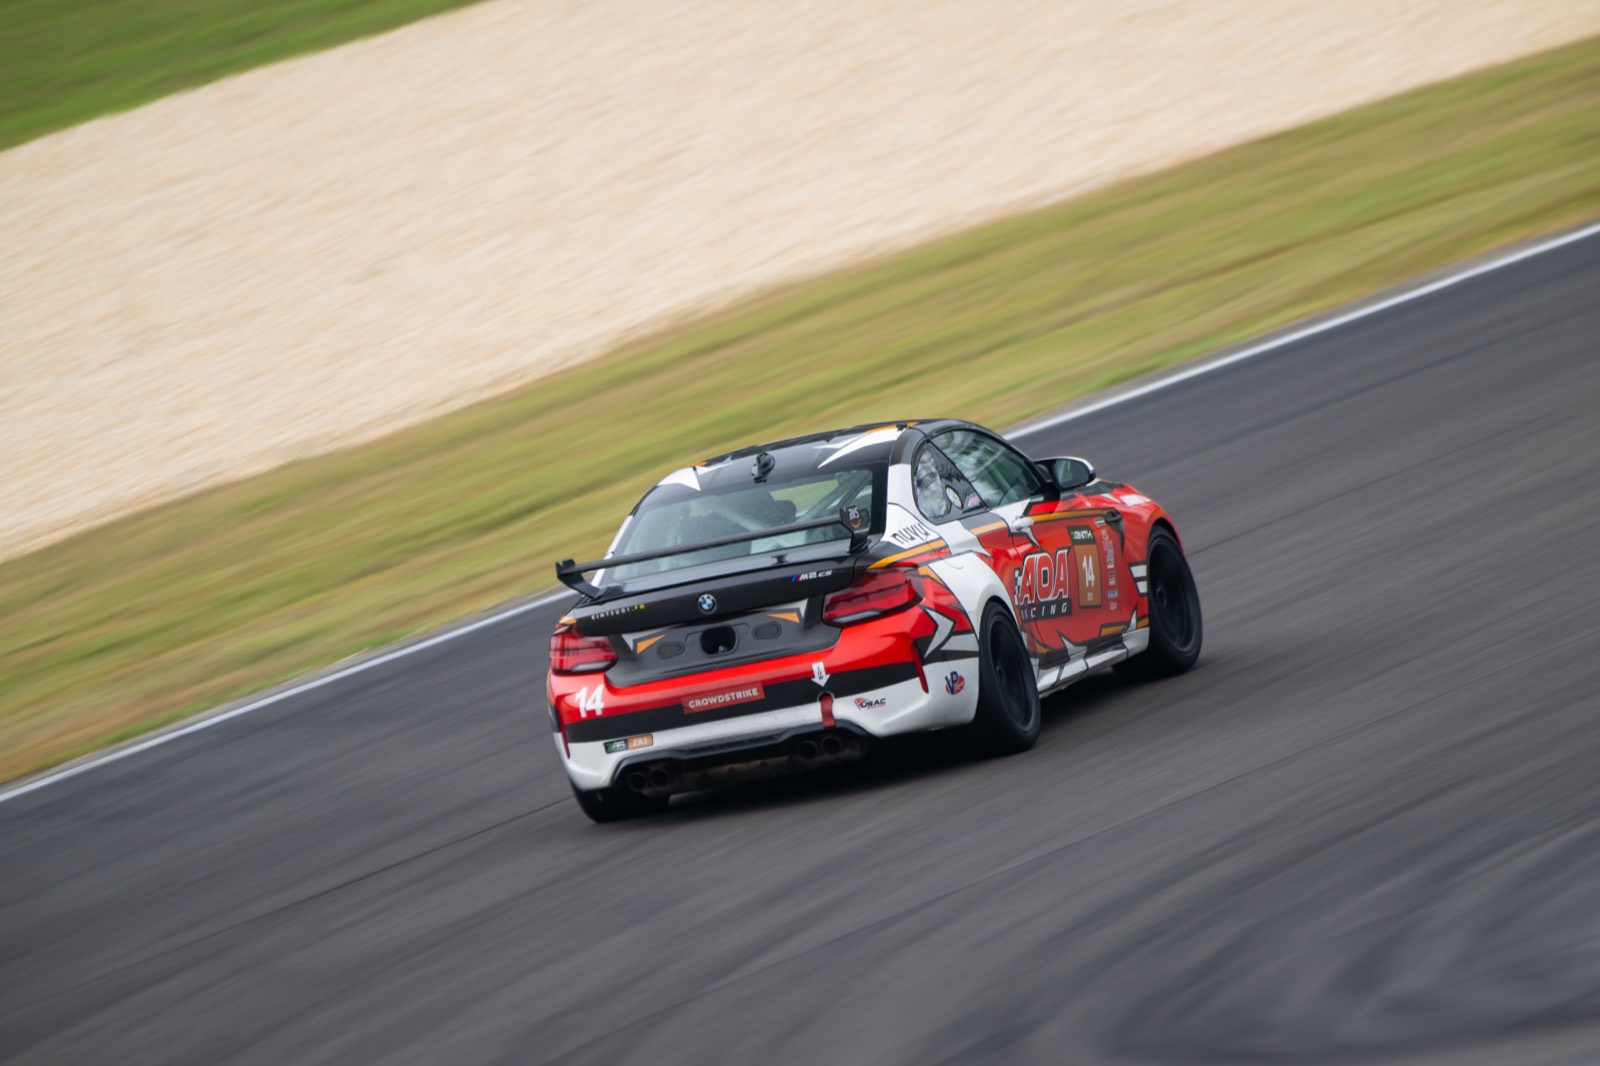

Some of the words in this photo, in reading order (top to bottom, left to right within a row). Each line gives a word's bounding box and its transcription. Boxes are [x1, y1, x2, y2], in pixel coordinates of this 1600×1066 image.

[1019, 549, 1070, 605] AOA
[1082, 554, 1095, 587] 14
[944, 670, 959, 695] VP
[575, 684, 604, 718] 14
[688, 688, 759, 708] CROWDSTRIKE
[860, 698, 886, 708] USAC
